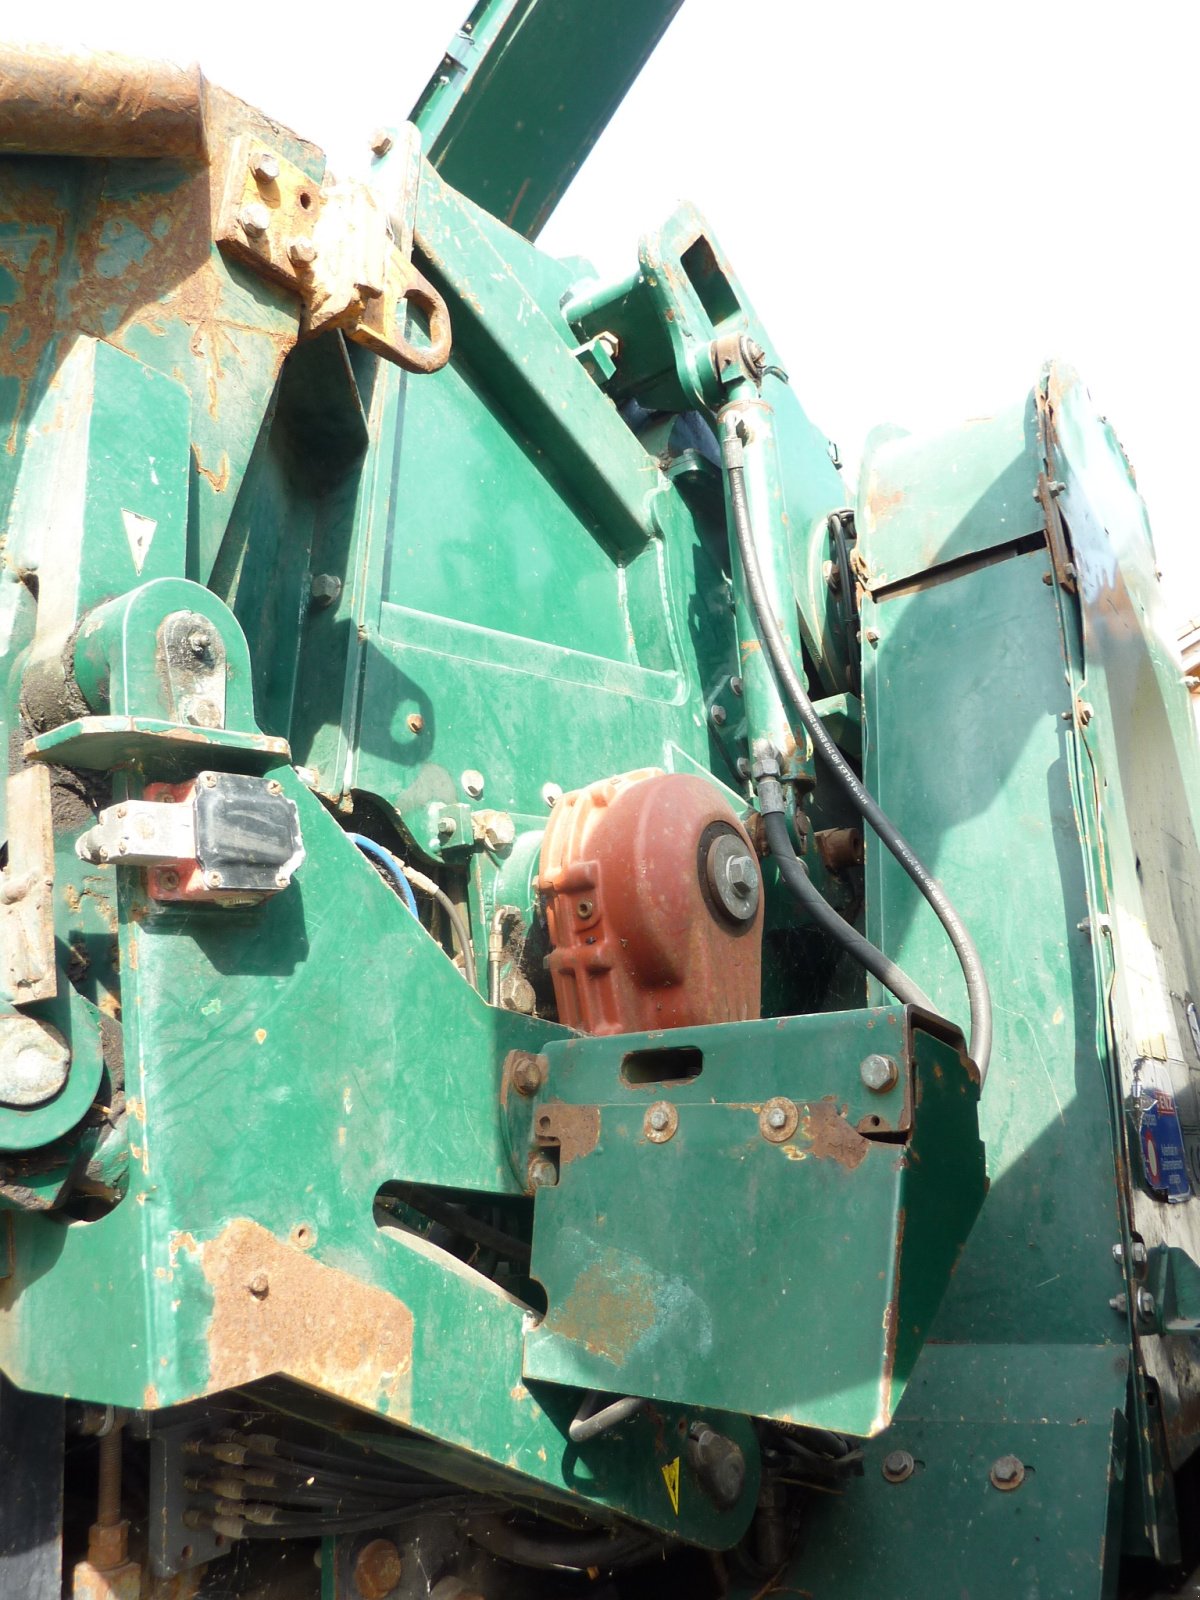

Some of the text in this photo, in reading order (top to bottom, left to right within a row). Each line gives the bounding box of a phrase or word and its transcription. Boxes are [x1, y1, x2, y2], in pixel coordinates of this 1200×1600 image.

[803, 708, 816, 724] 2SN
[810, 721, 828, 744] EN853
[822, 741, 835, 755] 210
[829, 752, 842, 765] HD
[930, 887, 943, 902] WP
